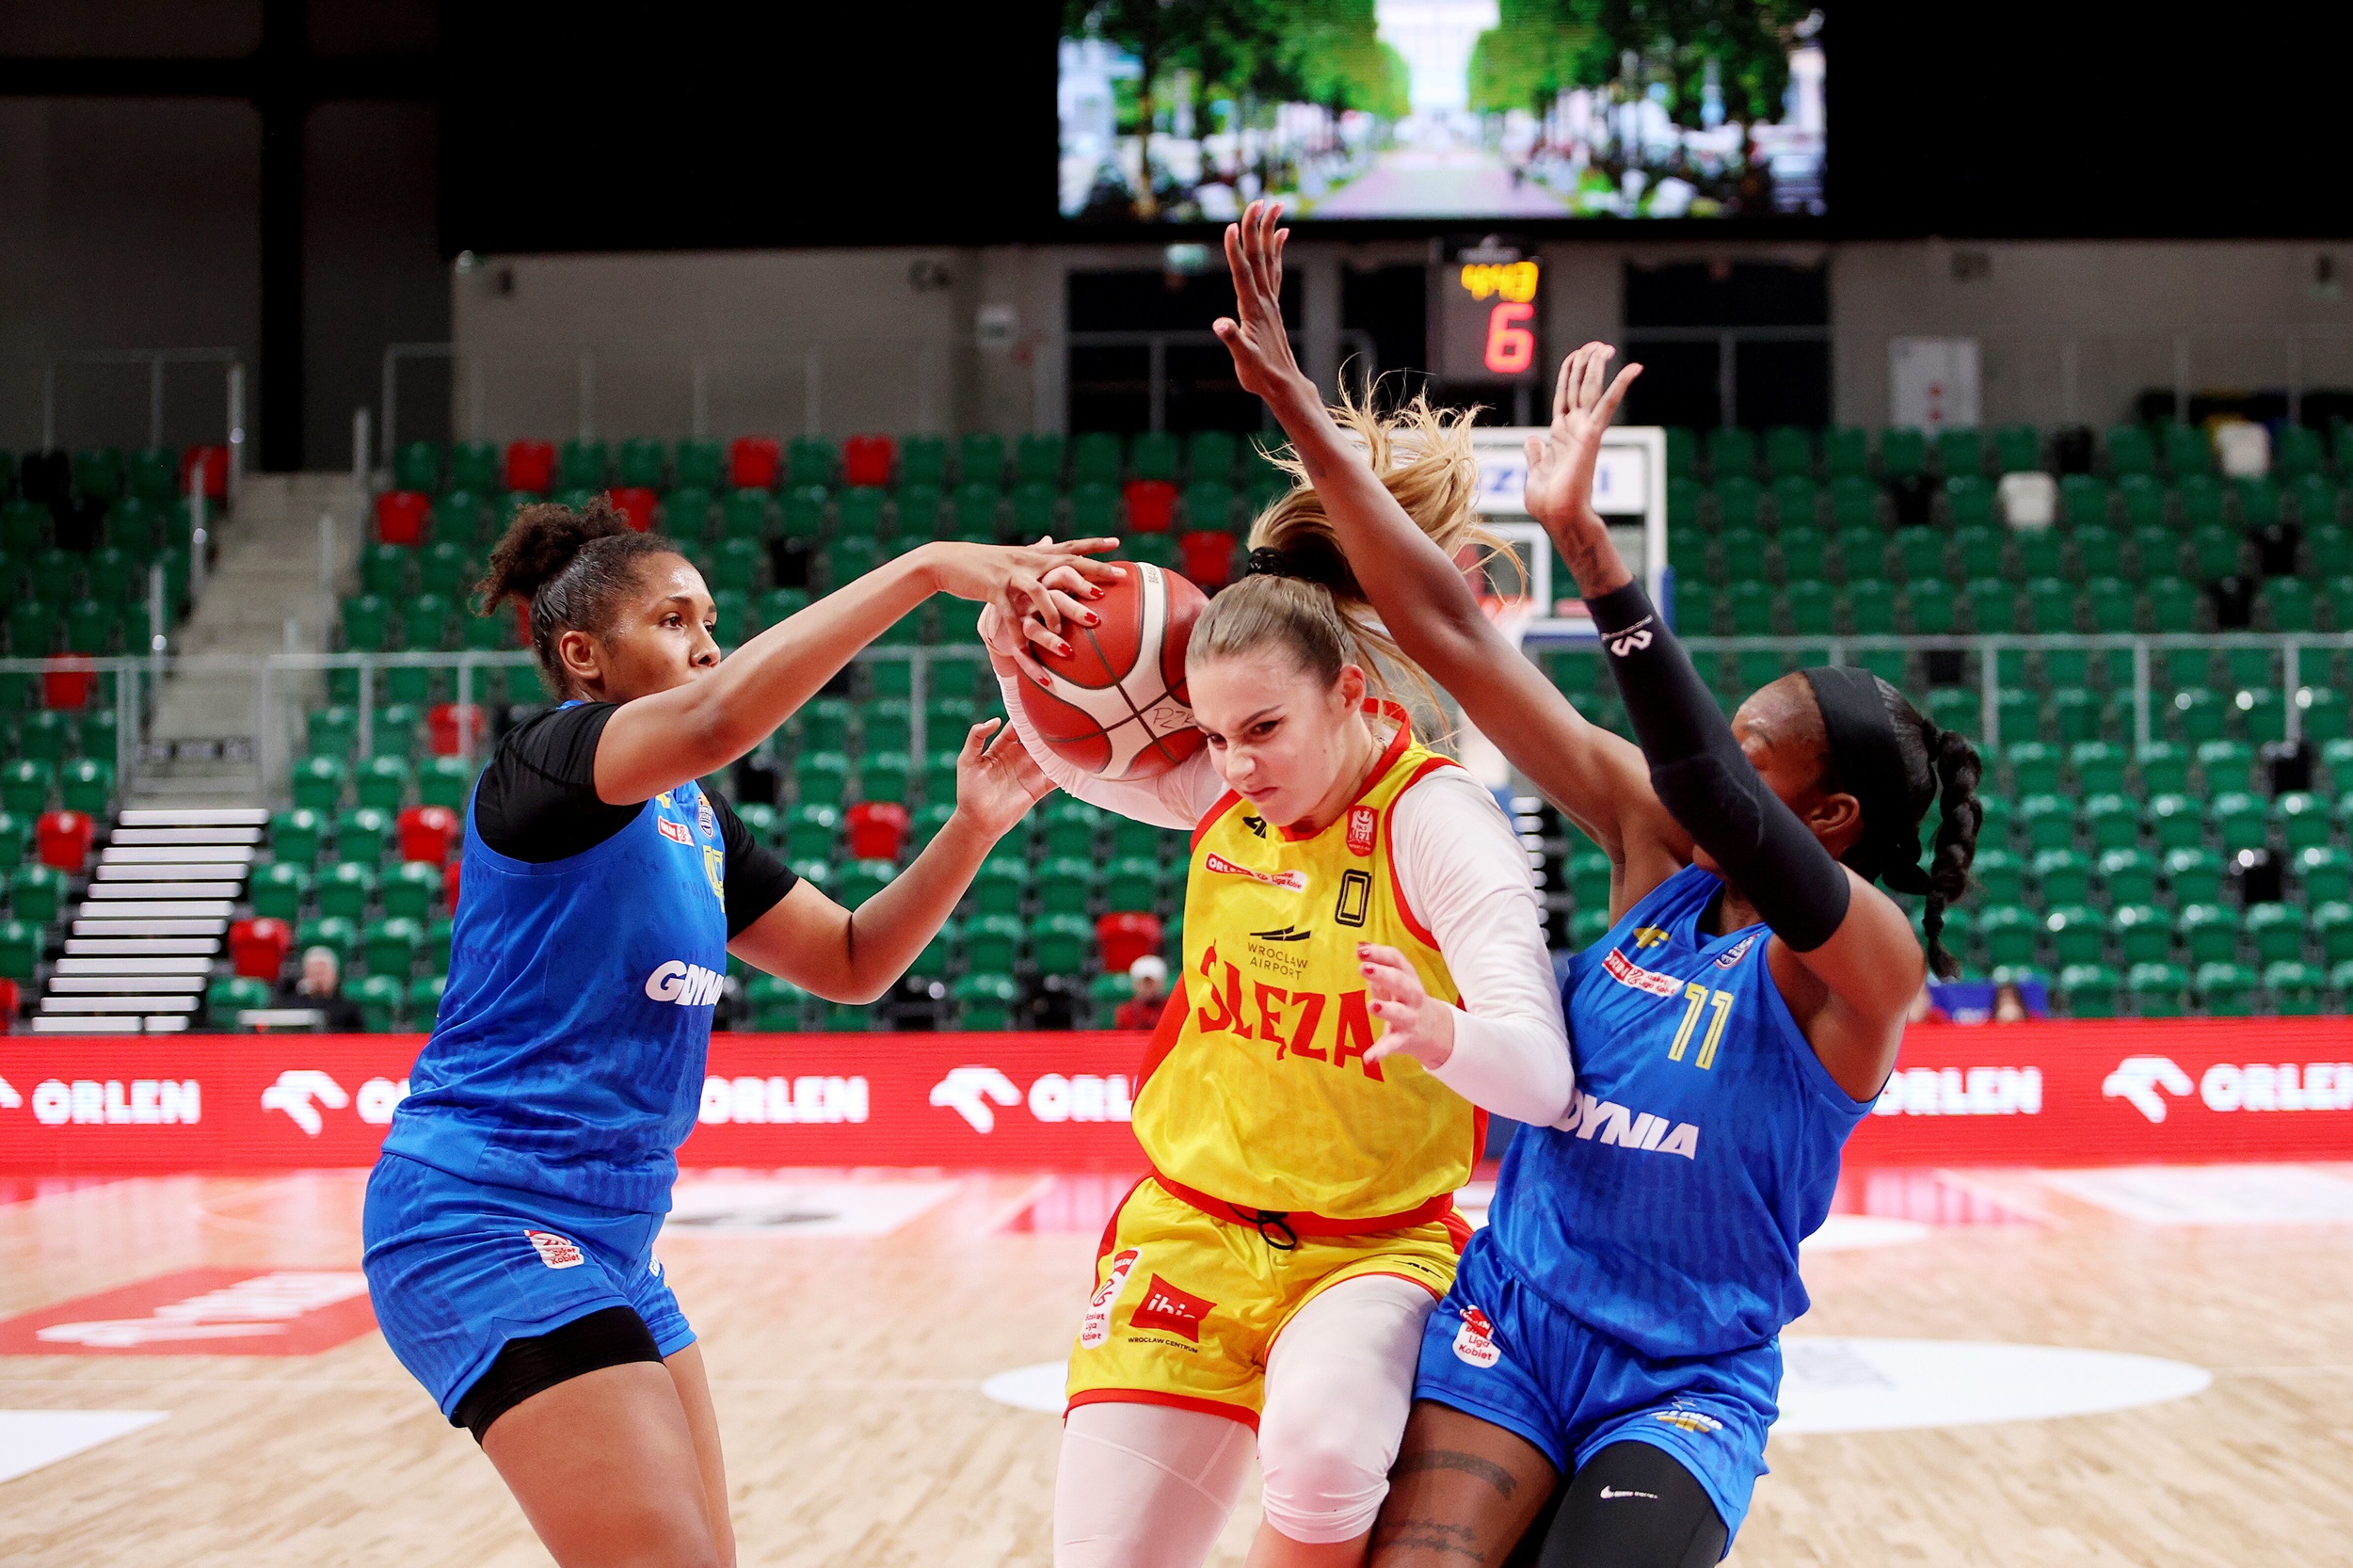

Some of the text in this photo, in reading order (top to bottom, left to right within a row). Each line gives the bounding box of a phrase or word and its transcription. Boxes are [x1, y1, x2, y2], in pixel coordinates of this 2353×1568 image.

[1484, 302, 1535, 373] 6
[1335, 868, 1372, 928] 0
[1250, 956, 1303, 981] AIRPORT
[1197, 937, 1385, 1082] ŚLĘZA
[1667, 982, 1735, 1070] 11
[32, 1079, 201, 1126] ORLEN
[699, 1076, 870, 1124] ORLEN
[1028, 1073, 1133, 1123] ORL
[1872, 1066, 2042, 1115] ORLEN
[1553, 1087, 1700, 1160] DYNIA
[1165, 1339, 1198, 1353] CENTRUM
[1459, 1344, 1492, 1360] Kobiet
[1468, 1335, 1490, 1348] Liga
